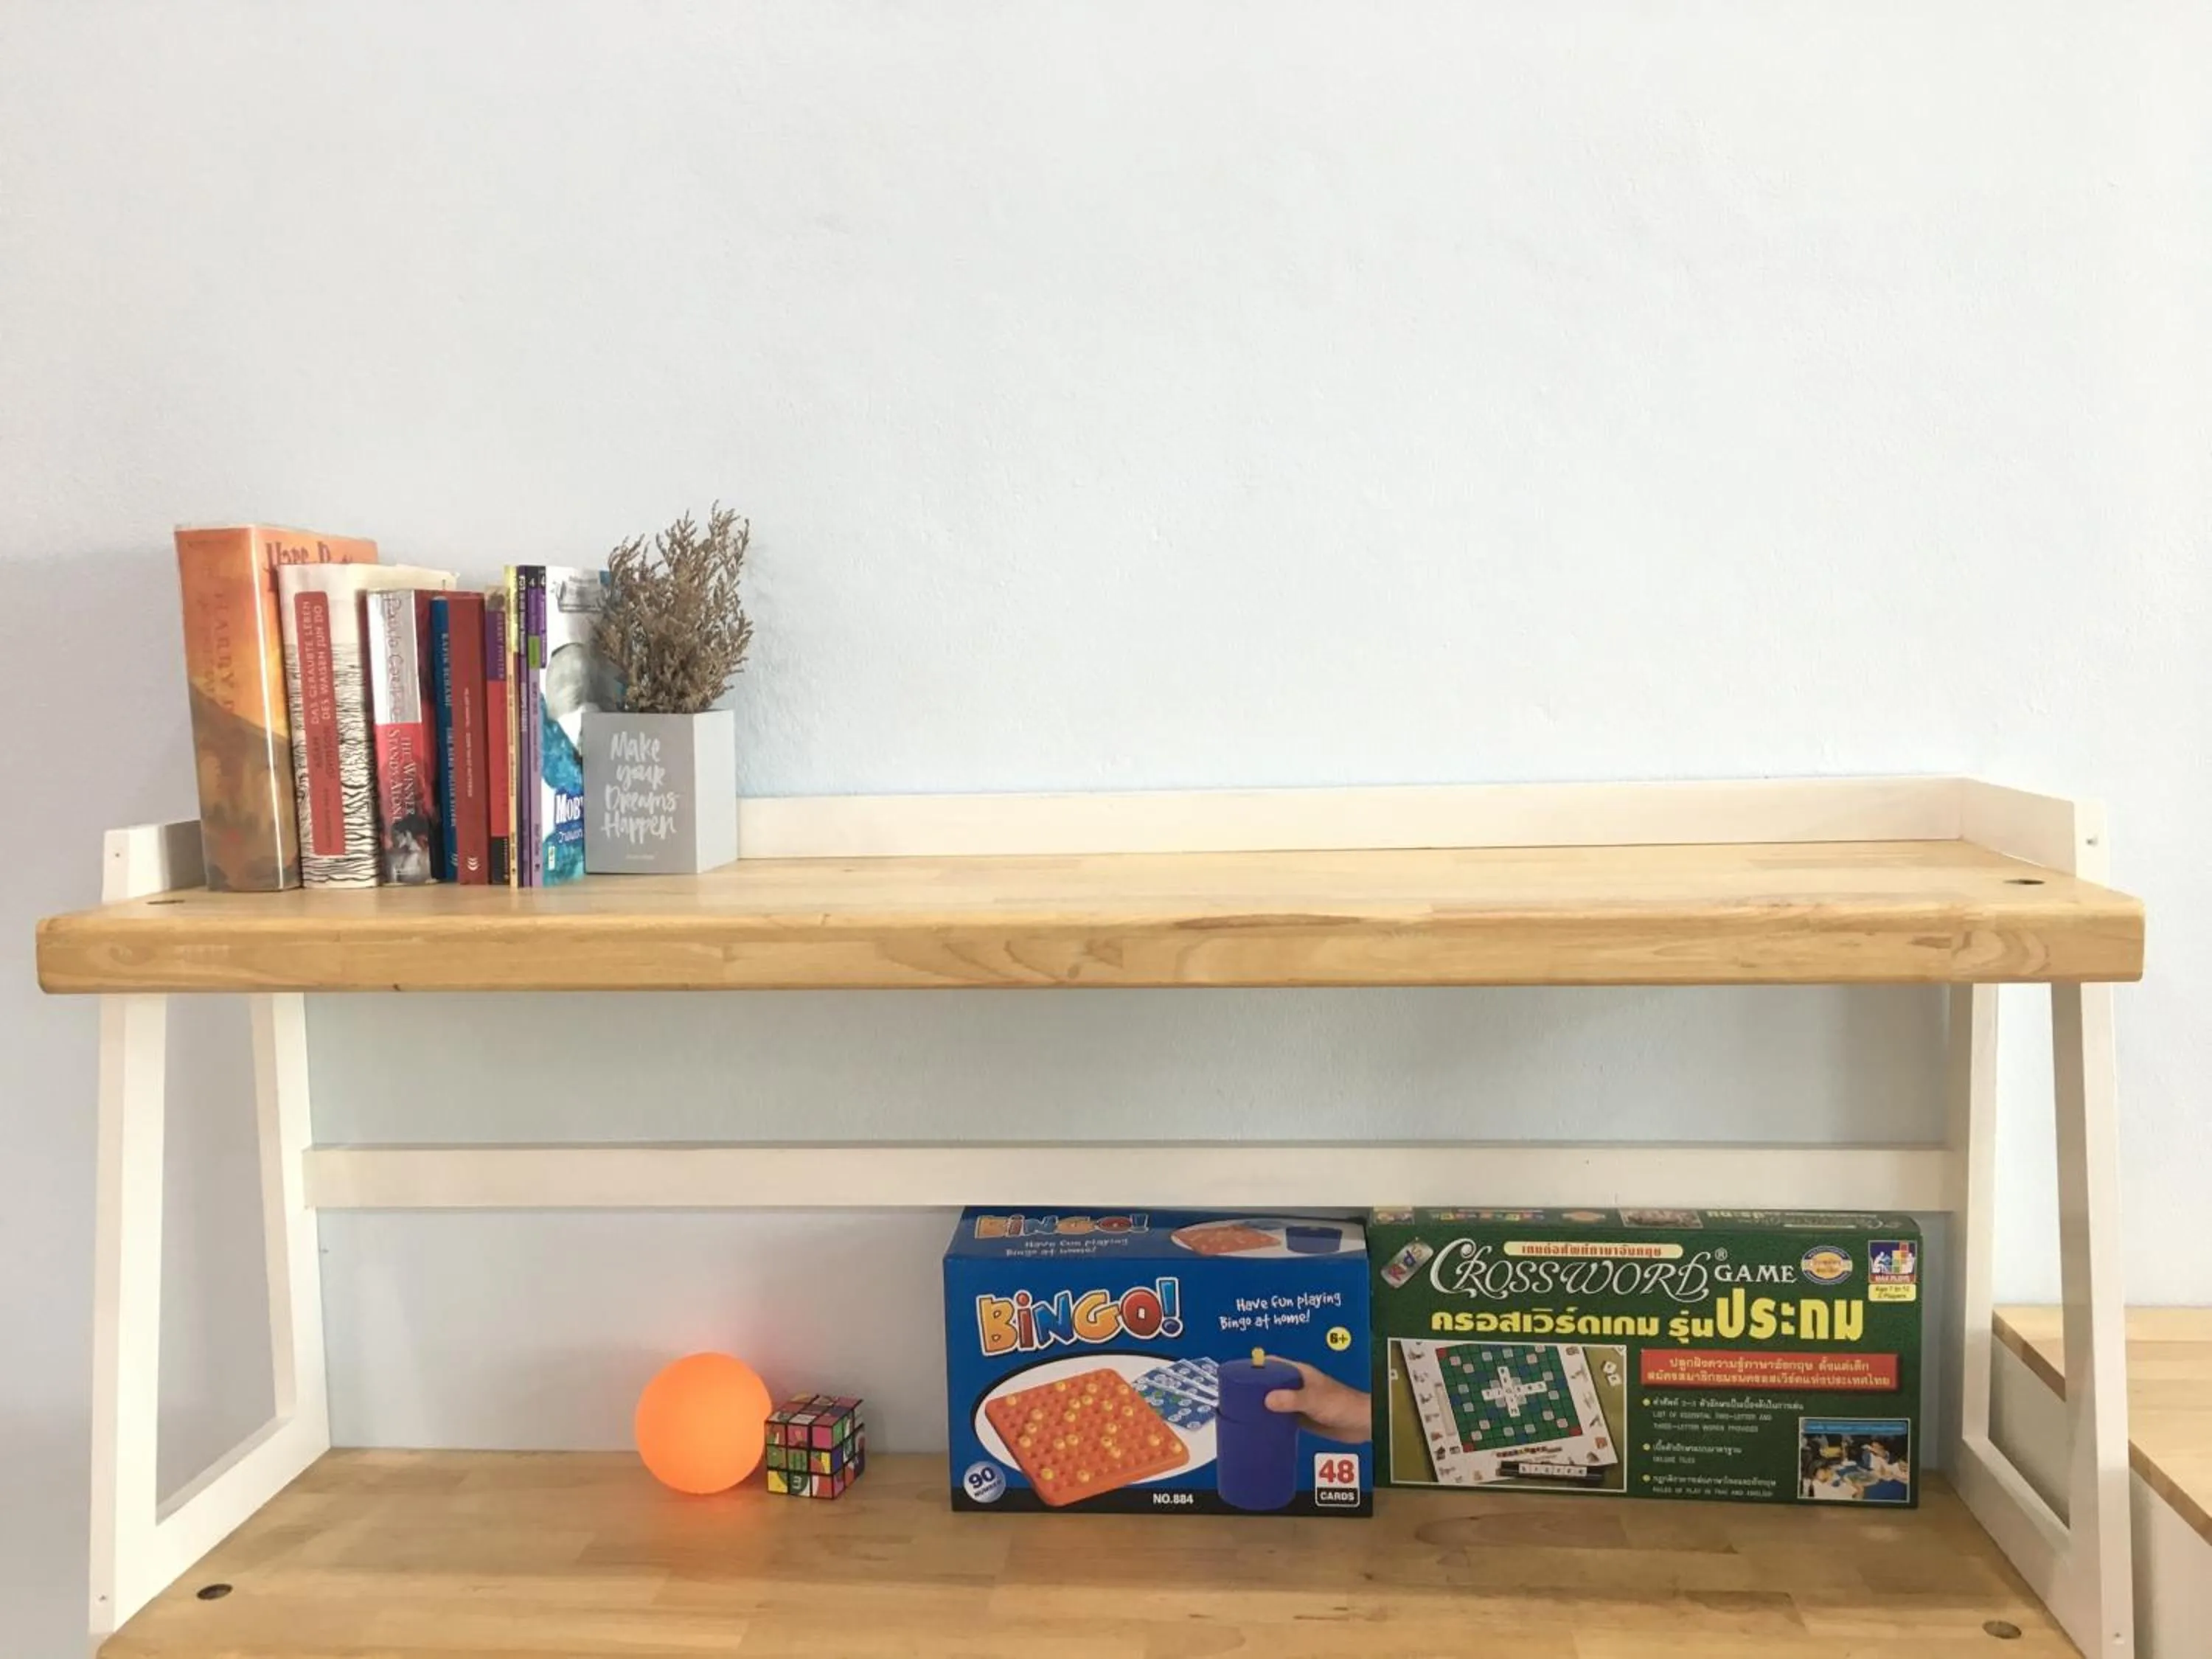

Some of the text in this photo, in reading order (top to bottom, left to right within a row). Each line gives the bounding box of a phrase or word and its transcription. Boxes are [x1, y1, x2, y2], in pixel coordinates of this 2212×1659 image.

[302, 600, 313, 636] LEBEN
[313, 605, 331, 720] DES WAISEN JUN DO
[310, 702, 320, 725] DAS
[611, 731, 661, 762] Make
[616, 765, 665, 790] your
[604, 784, 681, 815] Dreams
[599, 811, 677, 844] Happen
[1714, 1263, 1797, 1283] GAME
[1236, 1292, 1341, 1312] Have fun playing
[1219, 1309, 1311, 1331] Bingo at home!
[1329, 1332, 1349, 1345] 6+
[968, 1467, 995, 1489] 90
[1318, 1459, 1355, 1484] 48
[1152, 1493, 1194, 1506] NO.884
[1320, 1491, 1355, 1501] CARDS
